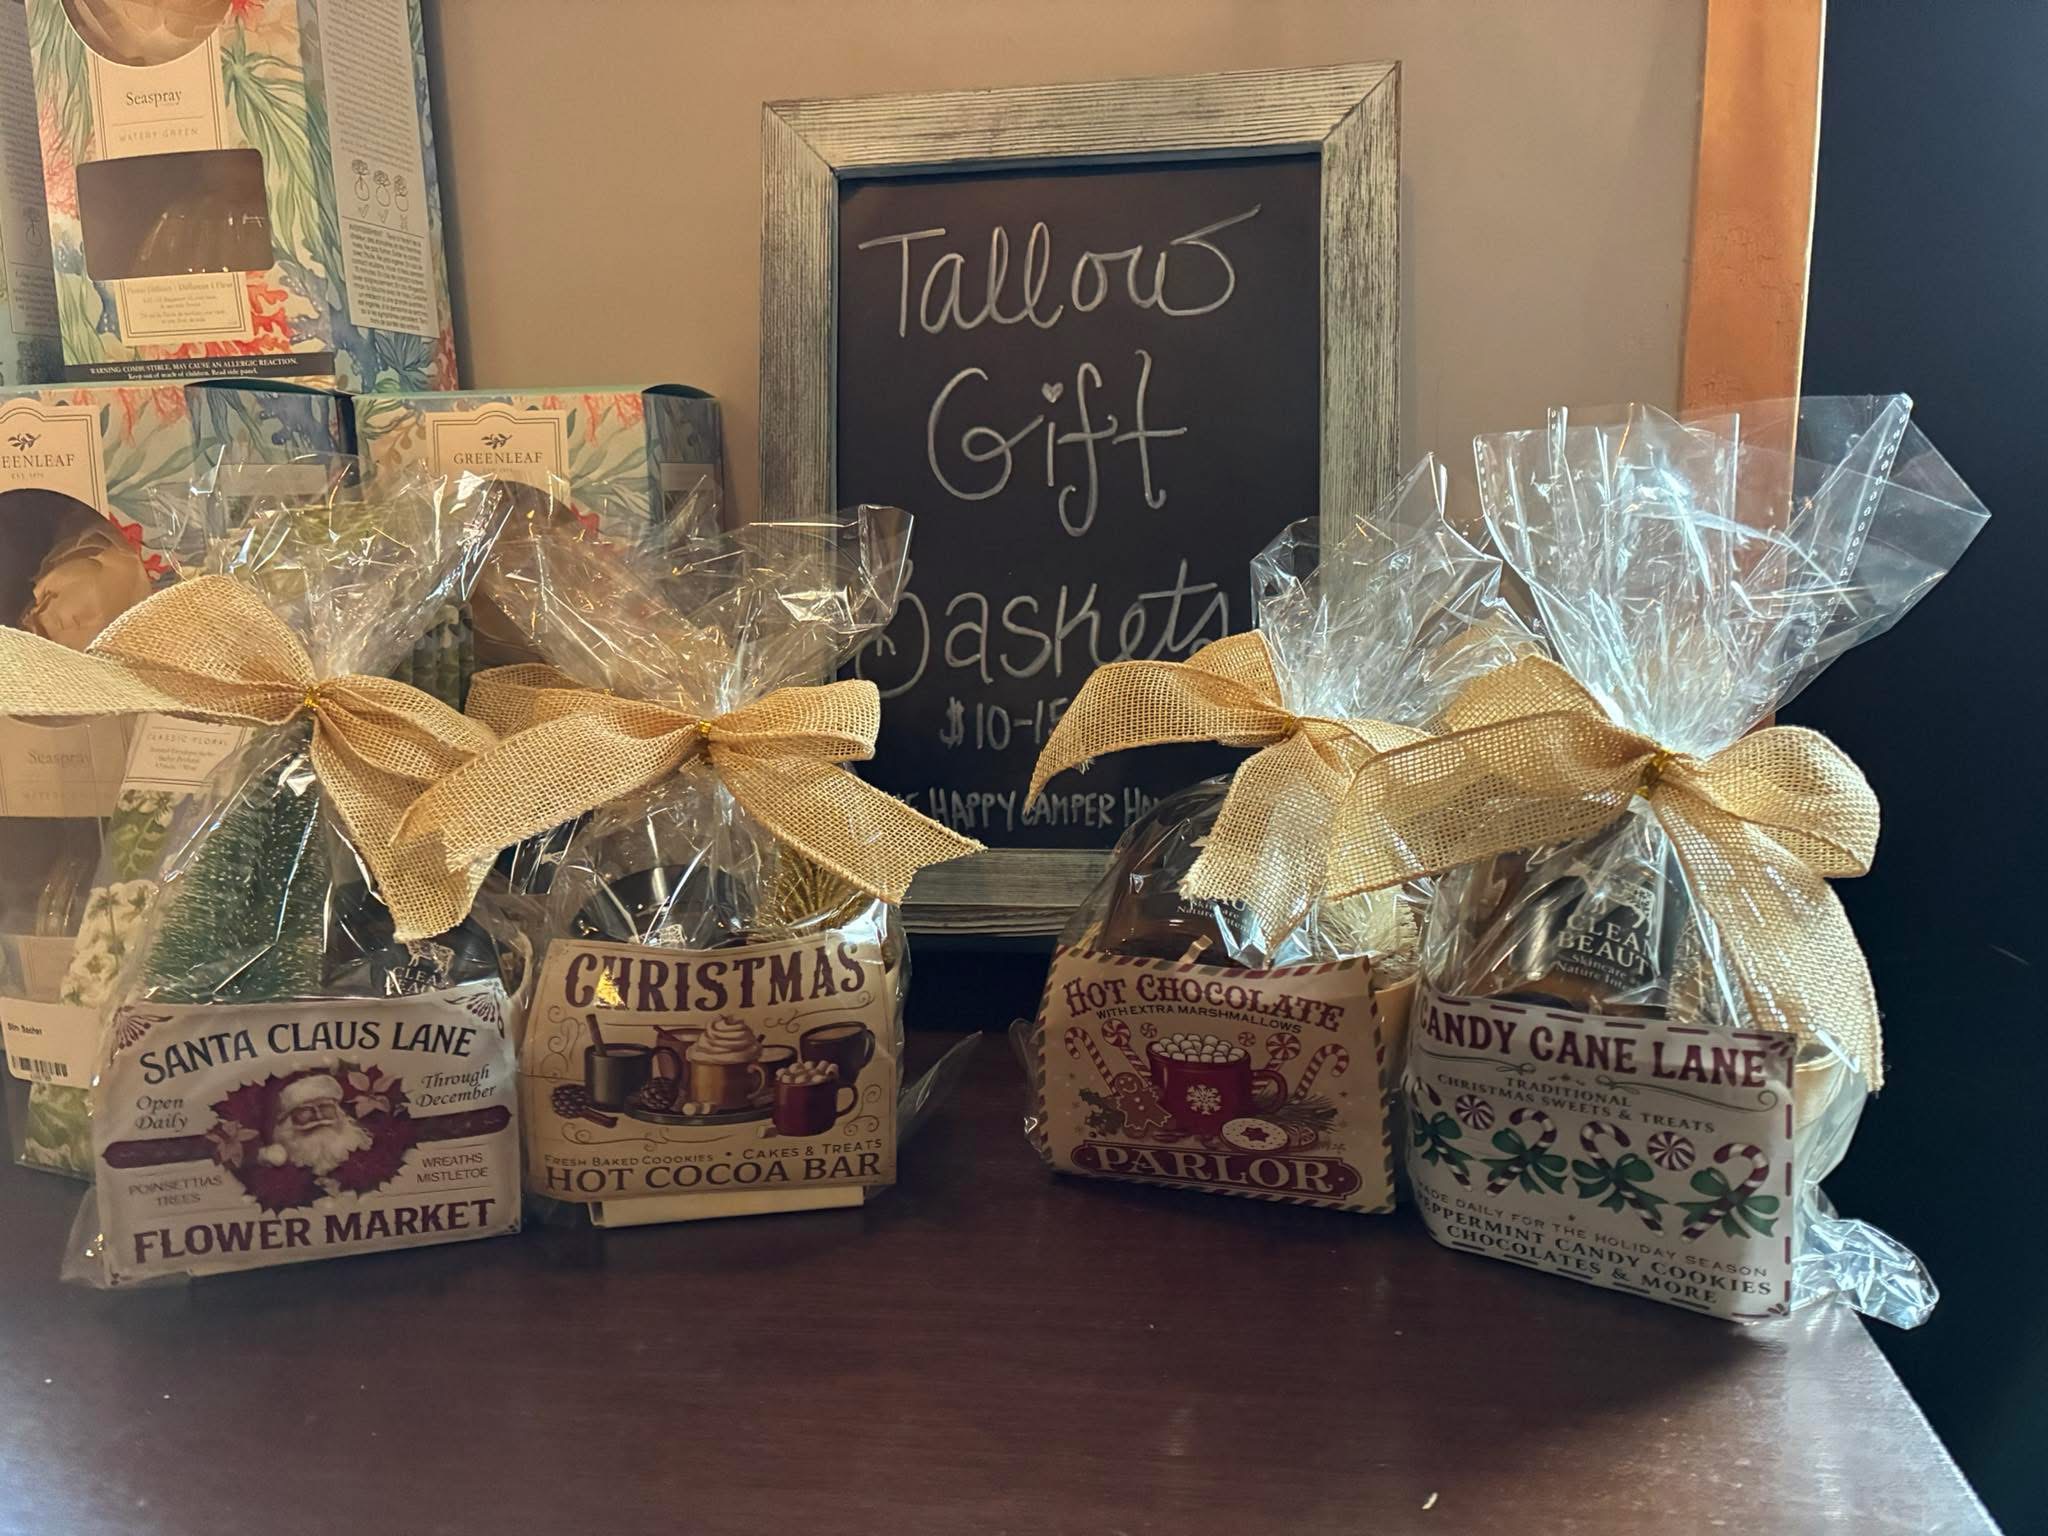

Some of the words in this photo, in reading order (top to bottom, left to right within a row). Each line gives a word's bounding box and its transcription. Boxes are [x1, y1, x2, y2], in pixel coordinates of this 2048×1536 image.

[126, 89, 182, 108] Seaspray
[858, 202, 1263, 338] Tallow
[172, 362, 187, 371] MAY
[212, 360, 222, 368] AN
[223, 358, 258, 368] ALLERGIC
[453, 451, 543, 465] GREENLEAF
[927, 349, 1188, 537] Gift
[929, 786, 1017, 832] HAPPY
[1557, 930, 1650, 976] BEAUT
[564, 942, 866, 1012] CHRISTMAS
[1063, 977, 1126, 1018] HOT
[1135, 973, 1345, 1032] CHOCOLATE
[1096, 1006, 1129, 1020] WITH
[1130, 1004, 1175, 1016] EXTRA
[1177, 1005, 1303, 1034] MARSHMALLOWS
[139, 1029, 258, 1086] SANTA
[267, 1020, 381, 1055] CLAUS
[391, 1021, 477, 1058] LANE
[1419, 995, 1517, 1055] CANDY
[1529, 1026, 1638, 1075] CANE
[1651, 1041, 1767, 1088] LANE
[416, 1084, 497, 1108] December
[421, 1063, 490, 1088] Through
[1505, 1076, 1633, 1108] TRADITIONAL
[135, 1112, 188, 1133] Daily
[136, 1095, 184, 1115] Open
[1437, 1073, 1536, 1103] CHRISTMAS
[1540, 1095, 1612, 1118] SWEETS
[1617, 1108, 1633, 1121] &
[1639, 1112, 1716, 1134] TREATS
[416, 1166, 489, 1183] MISTLETOE
[422, 1151, 483, 1169] WREATHS
[544, 1165, 635, 1193] HOT
[645, 1160, 790, 1189] COCOA
[802, 1152, 882, 1182] BAR
[592, 1156, 639, 1167] BAKED
[742, 1147, 800, 1161] CAKES
[805, 1145, 814, 1157] &
[821, 1138, 883, 1156] TREATS
[1095, 1145, 1334, 1193] PARLOR
[133, 1217, 312, 1264] FLOWER
[324, 1198, 496, 1244] MARKET
[1456, 1198, 1504, 1217] DAILY
[1511, 1213, 1545, 1230] FOR
[1552, 1223, 1588, 1240] THE
[1594, 1232, 1677, 1260] HOLIDAY
[1684, 1255, 1768, 1278] SEASON
[1446, 1224, 1602, 1275] CHOCOLATES
[1611, 1267, 1631, 1282] &
[1640, 1273, 1718, 1305] MORE
[1555, 1237, 1640, 1268] CANDY
[1651, 1261, 1772, 1296] COOKIES
